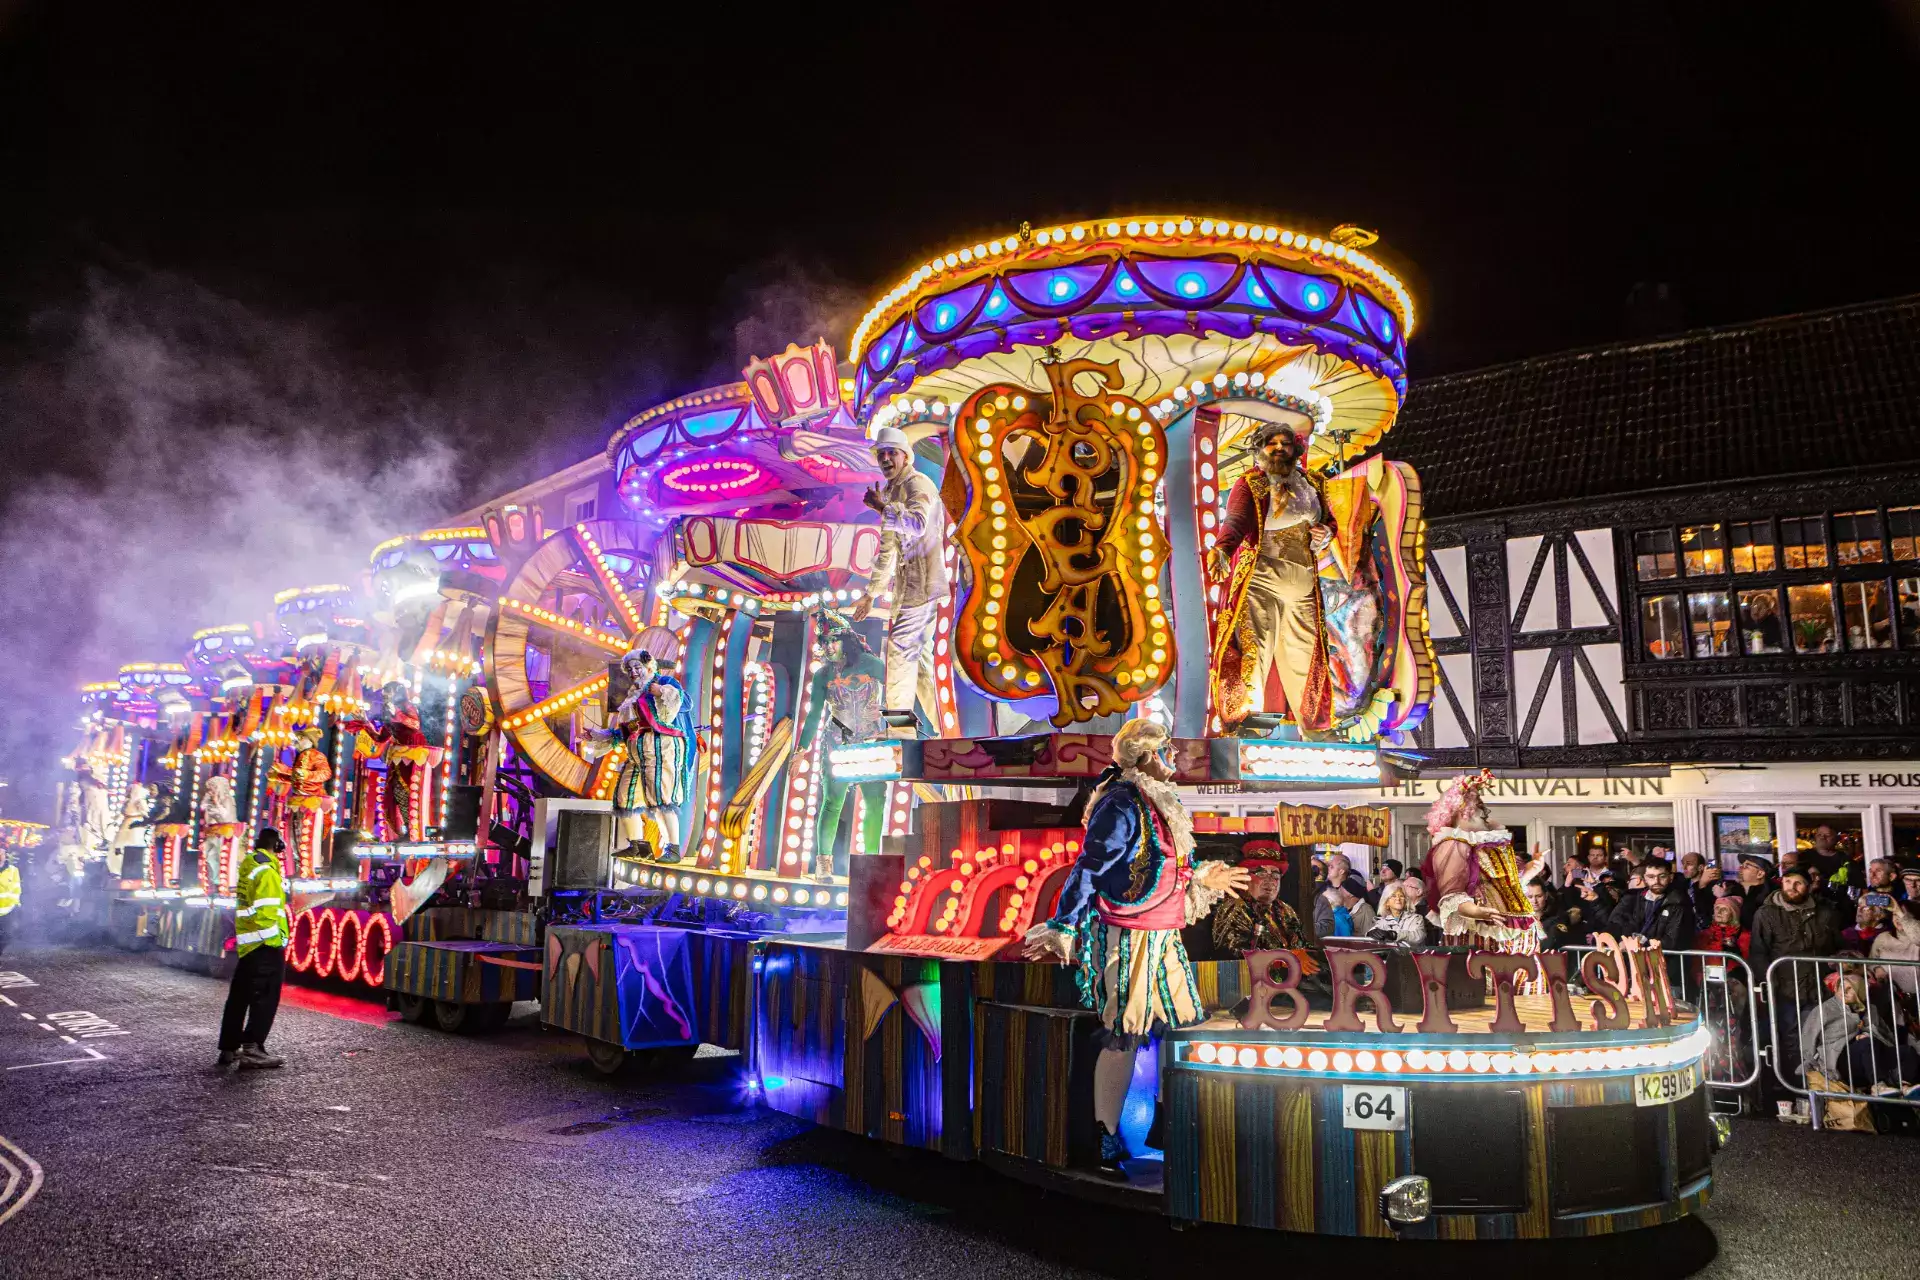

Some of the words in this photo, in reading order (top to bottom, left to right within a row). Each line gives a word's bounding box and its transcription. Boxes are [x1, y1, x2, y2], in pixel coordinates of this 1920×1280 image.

[1016, 358, 1131, 728] FREAK
[1436, 778, 1590, 796] CRNIVAL
[1602, 777, 1663, 795] INN
[1820, 773, 1862, 787] FREE
[1868, 773, 1920, 787] HOUS
[1288, 813, 1385, 838] TICKETS
[1242, 948, 1675, 1033] BRITISH
[1642, 1074, 1676, 1100] K299
[1354, 1092, 1395, 1121] 64
